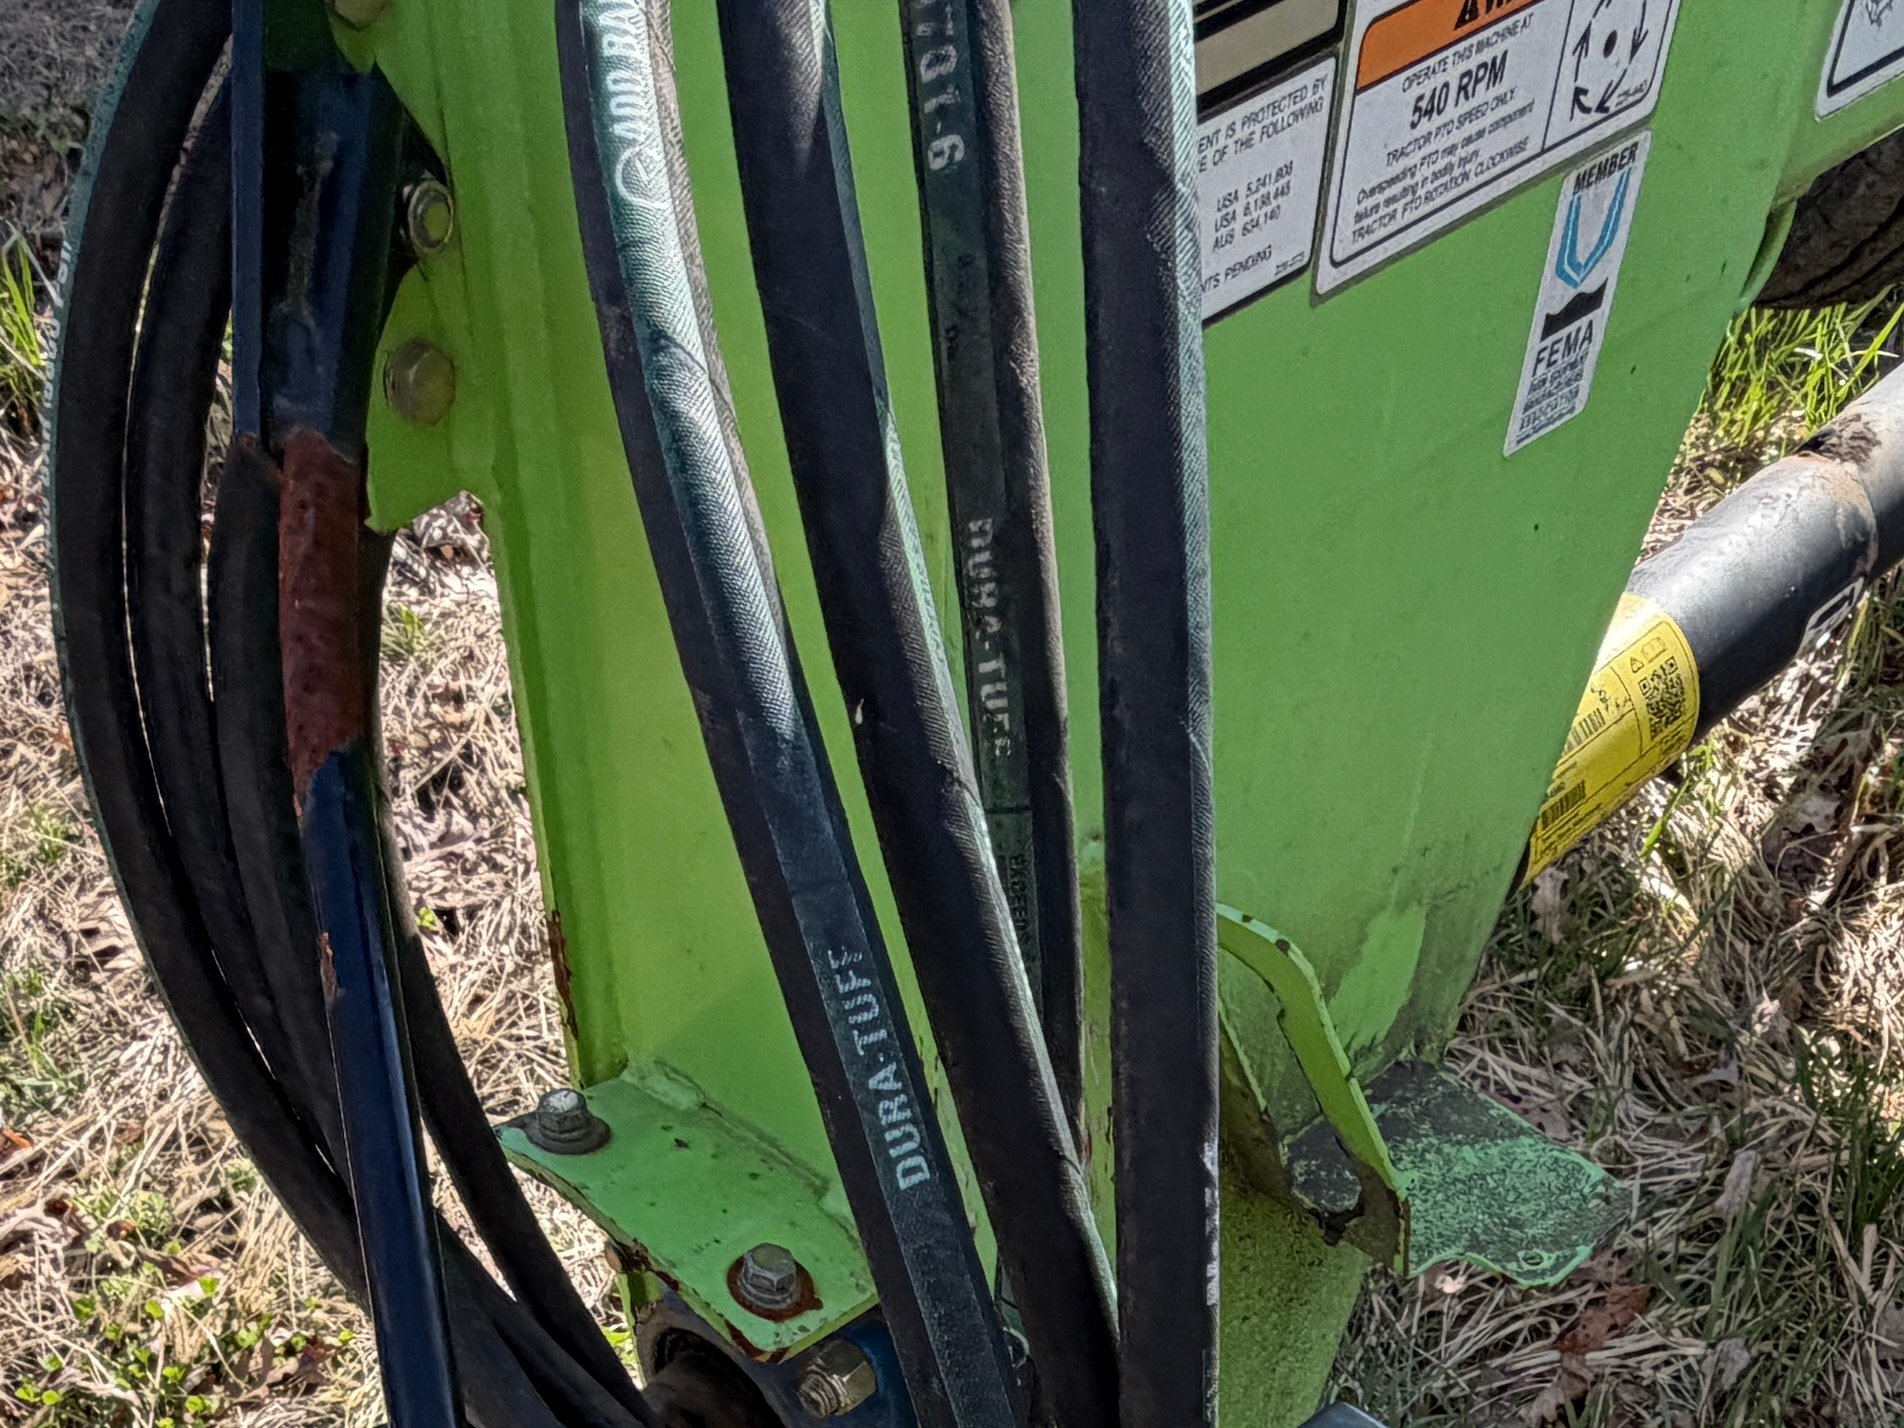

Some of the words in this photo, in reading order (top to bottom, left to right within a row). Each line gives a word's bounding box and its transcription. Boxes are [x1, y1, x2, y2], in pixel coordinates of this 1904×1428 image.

[1401, 56, 1448, 93] OPERATE
[1451, 44, 1474, 67] THIS
[1474, 20, 1519, 55] MACHINE
[1519, 12, 1534, 32] AT
[1225, 121, 1235, 139] IS
[1241, 84, 1307, 133] PROTECTED
[1312, 73, 1327, 95] BY
[1408, 78, 1451, 131] 540
[1454, 48, 1508, 107] RPM
[1212, 145, 1227, 165] OF
[1234, 130, 1256, 156] THE
[1259, 95, 1323, 143] FOLLOWING
[1385, 128, 1433, 168] TRACTOR
[1433, 118, 1454, 142] PTO
[1454, 101, 1489, 132] SPEED
[1489, 86, 1516, 112] ONLY
[1351, 209, 1397, 245] TRACTOR
[1400, 193, 1423, 219] PTO
[1473, 135, 1529, 179] CLOCKWISE
[1418, 148, 1440, 173] PTO
[1573, 141, 1639, 196] MEMBER
[1214, 207, 1236, 233] USA
[1217, 188, 1238, 212] USA
[1224, 244, 1271, 281] PENDING
[1532, 318, 1594, 378] FEMA
